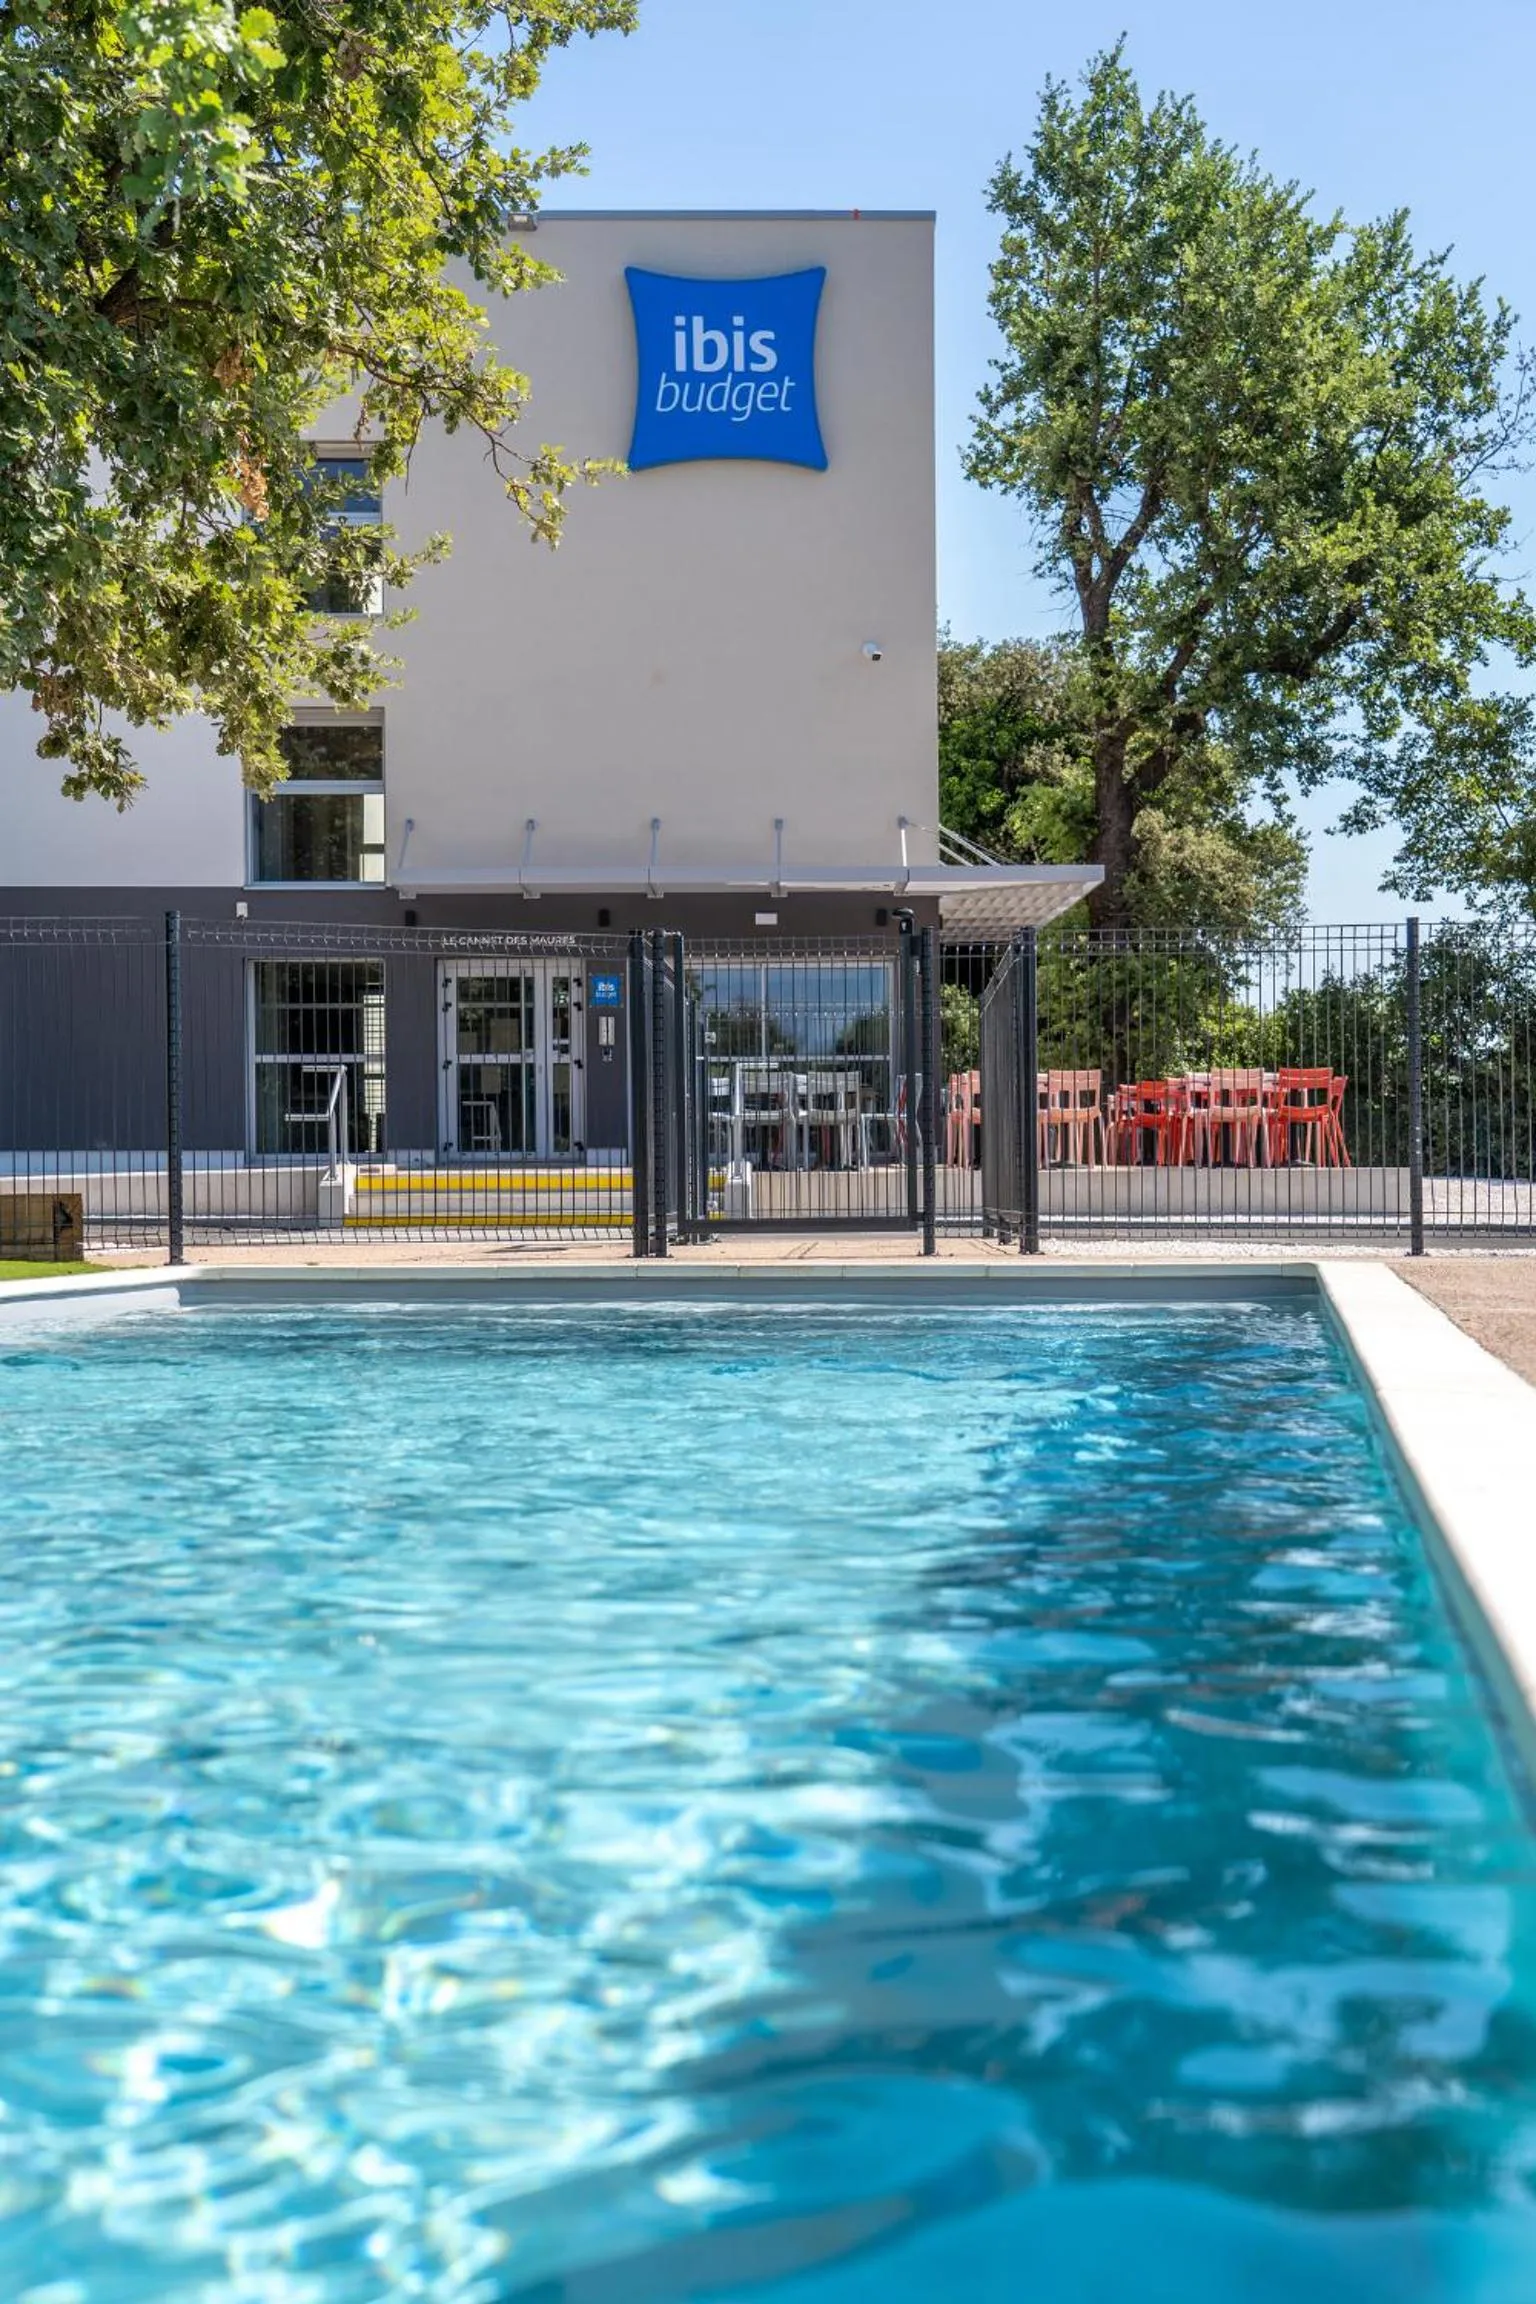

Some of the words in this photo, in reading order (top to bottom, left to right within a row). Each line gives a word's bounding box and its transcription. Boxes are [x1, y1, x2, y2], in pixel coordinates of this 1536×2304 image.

[674, 316, 778, 372] ibis
[656, 372, 795, 422] budget
[443, 936, 456, 946] LE
[458, 936, 503, 946] CANNET
[506, 936, 527, 945] DES
[530, 935, 576, 945] MAURES
[598, 981, 615, 991] ibis
